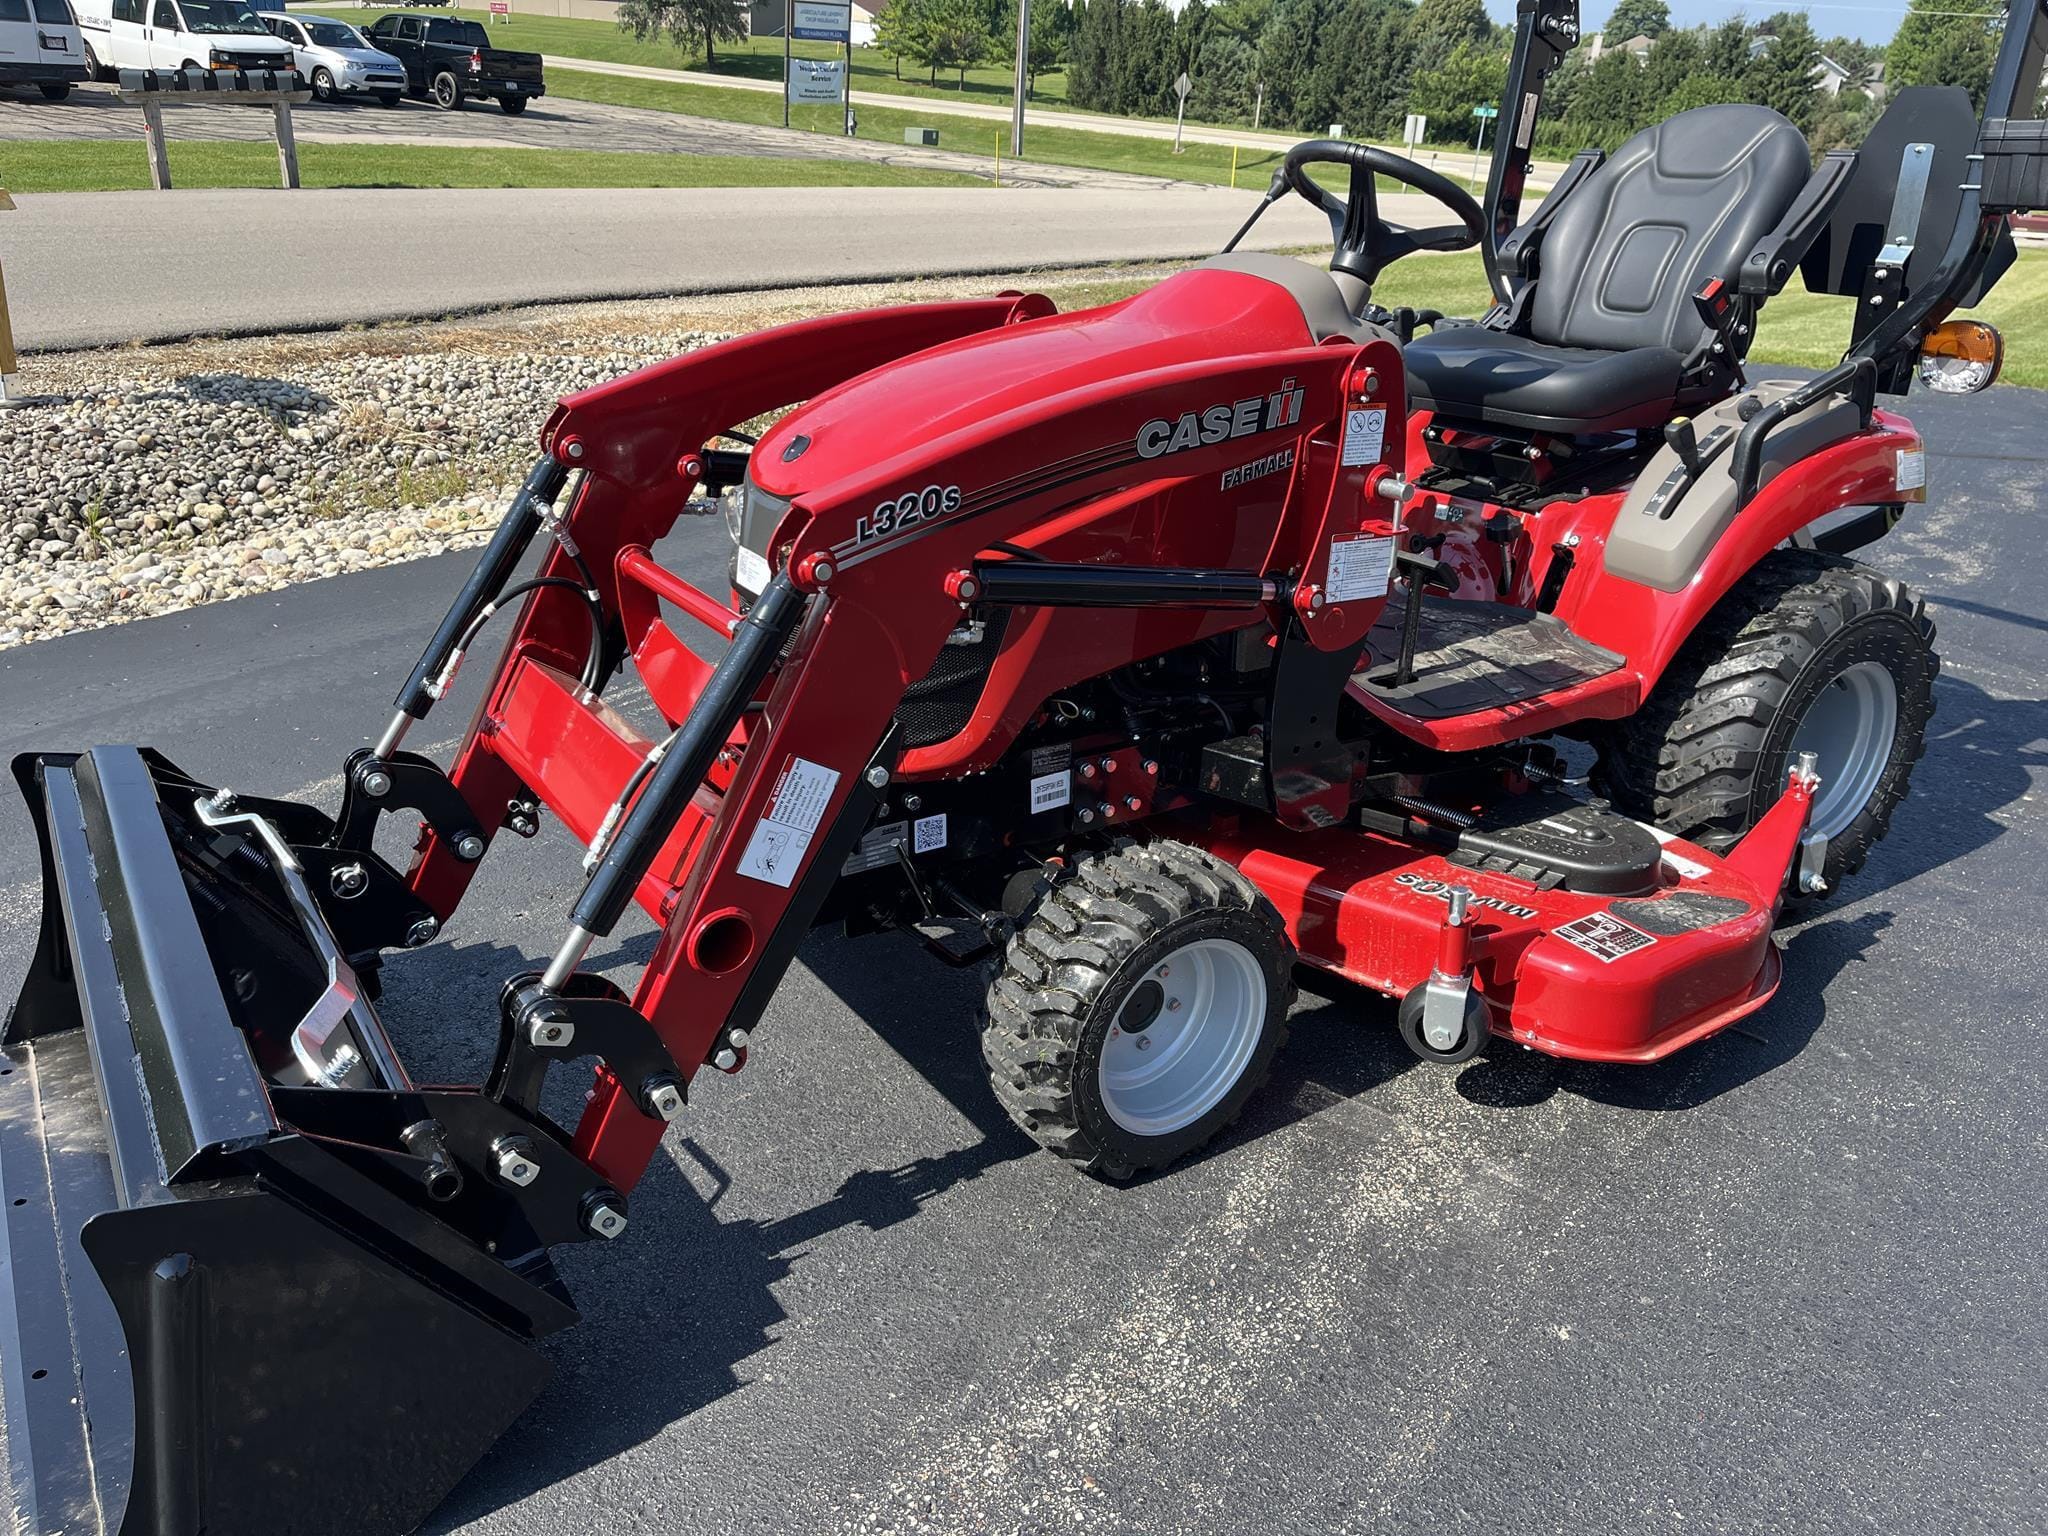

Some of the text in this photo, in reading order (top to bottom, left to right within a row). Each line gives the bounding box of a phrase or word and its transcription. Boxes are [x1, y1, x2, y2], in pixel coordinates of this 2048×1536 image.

[1136, 398, 1263, 459] CASE
[1221, 449, 1294, 491] FARMALL
[774, 772, 787, 795] DANGER
